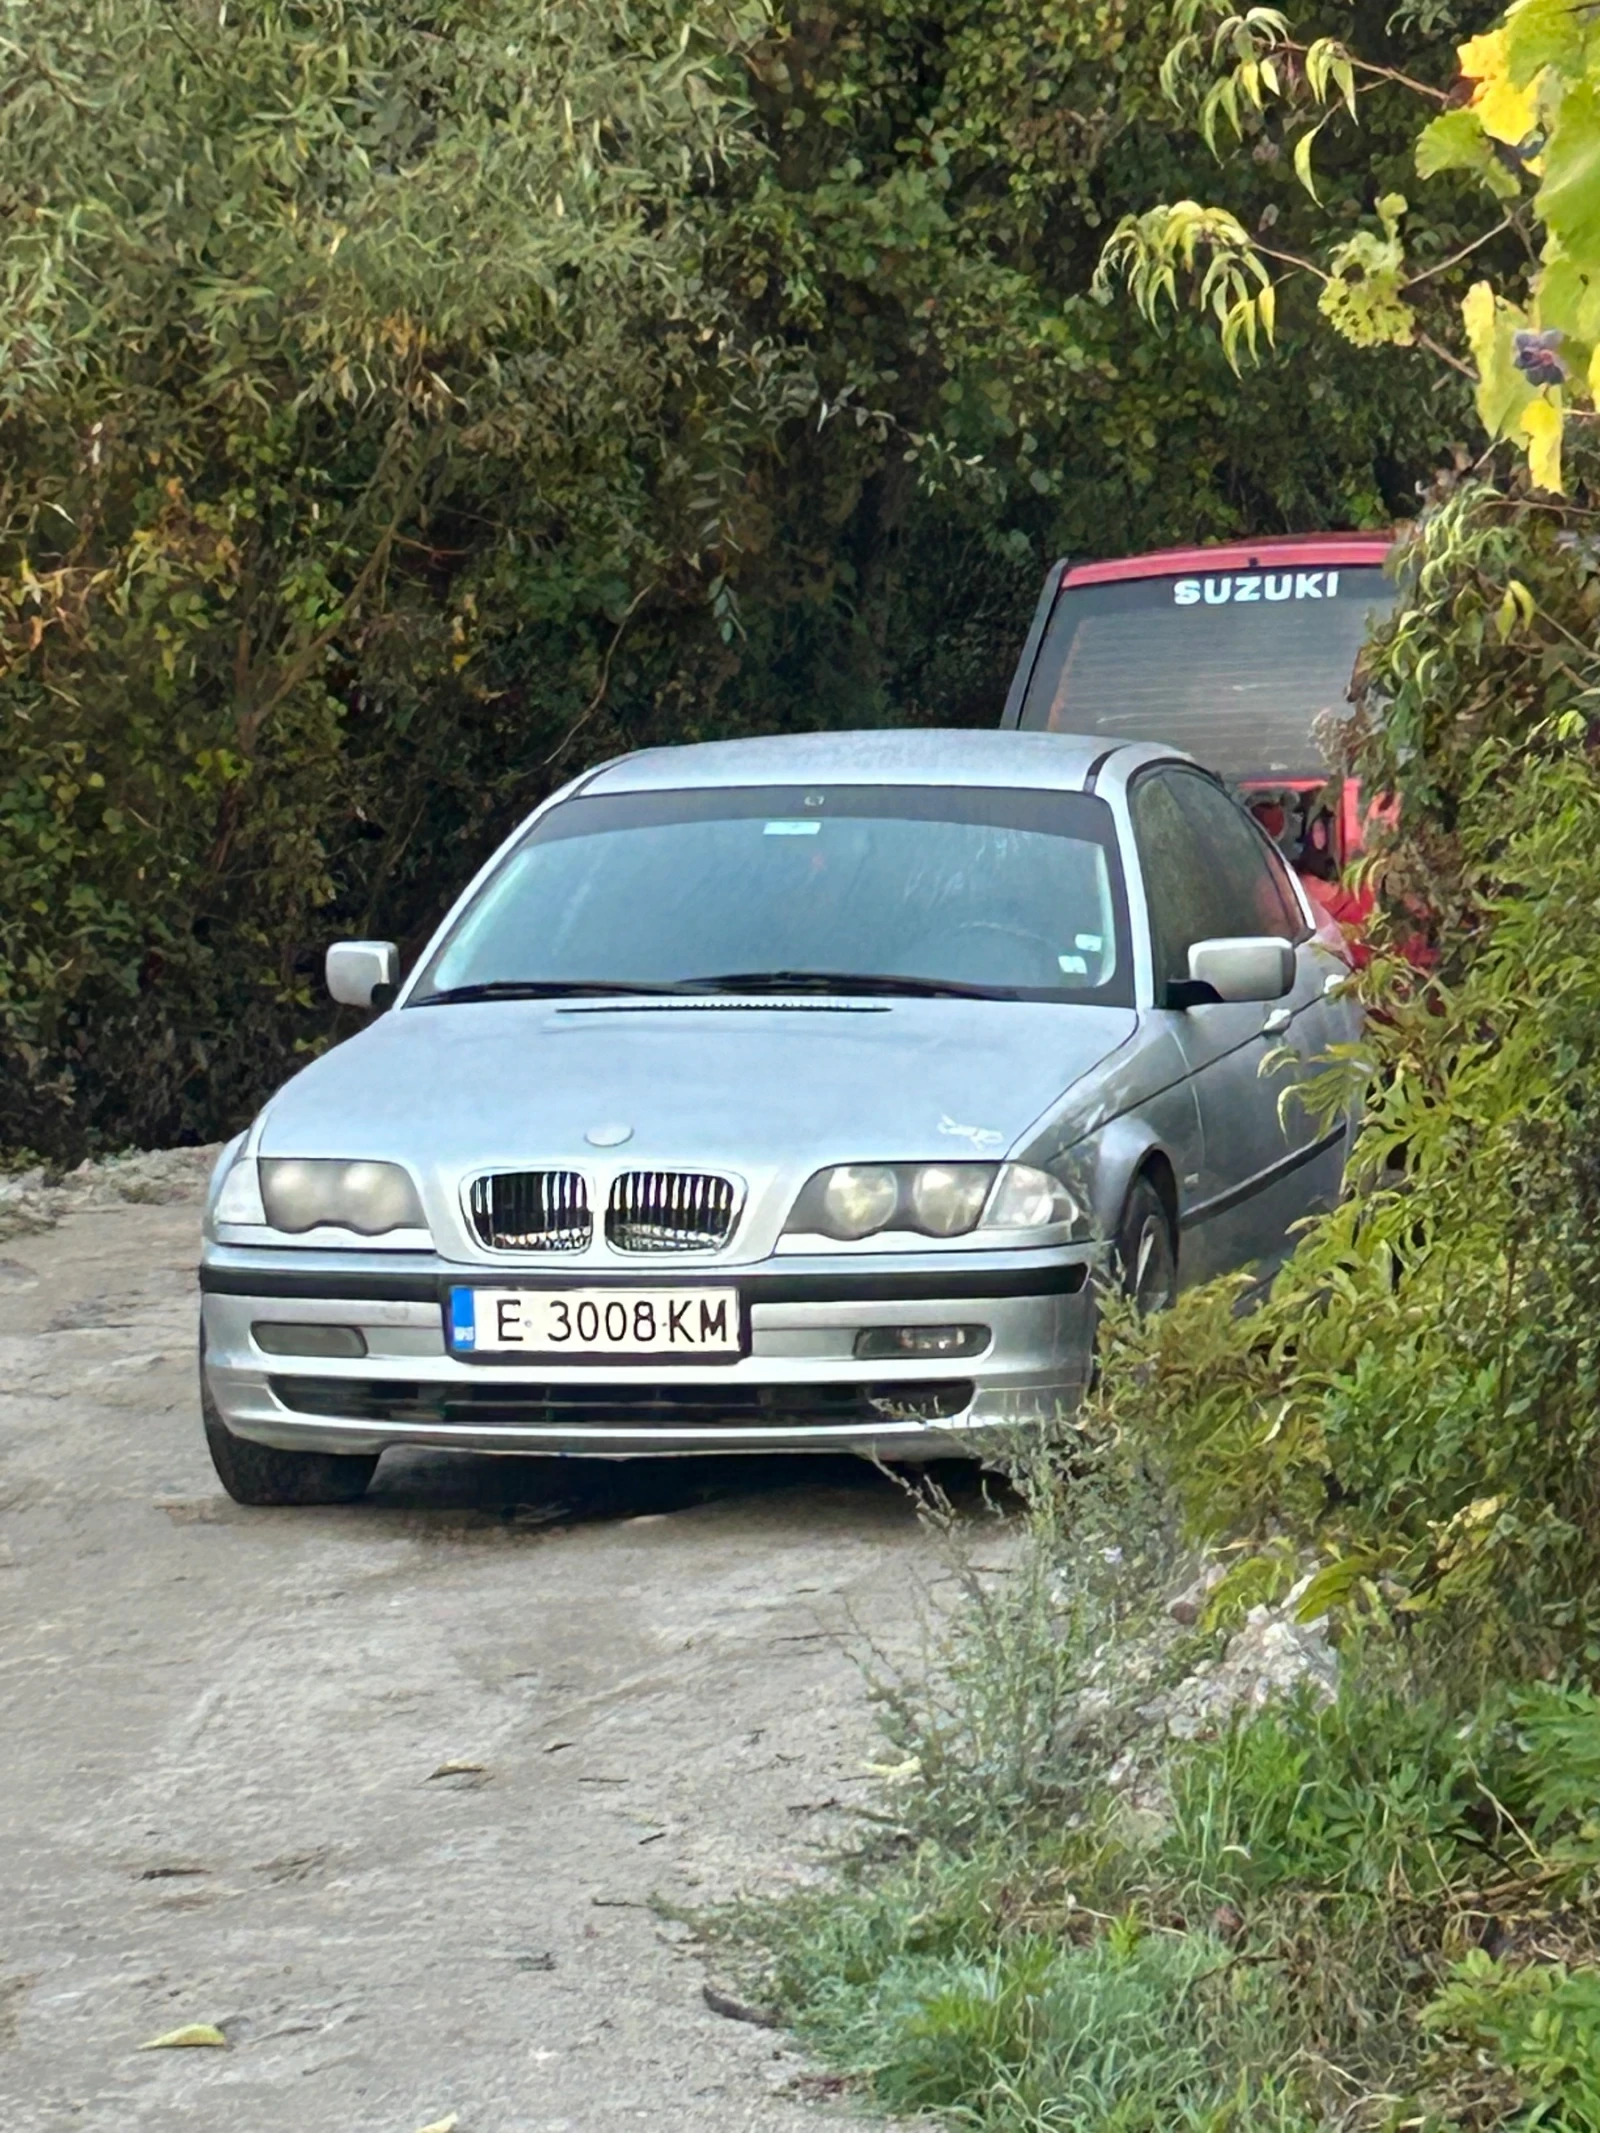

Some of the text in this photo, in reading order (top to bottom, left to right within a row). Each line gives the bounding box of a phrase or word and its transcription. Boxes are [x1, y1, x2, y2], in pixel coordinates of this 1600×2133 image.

[1174, 571, 1340, 605] SUZUKI
[497, 1299, 727, 1343] E 3008 KM
